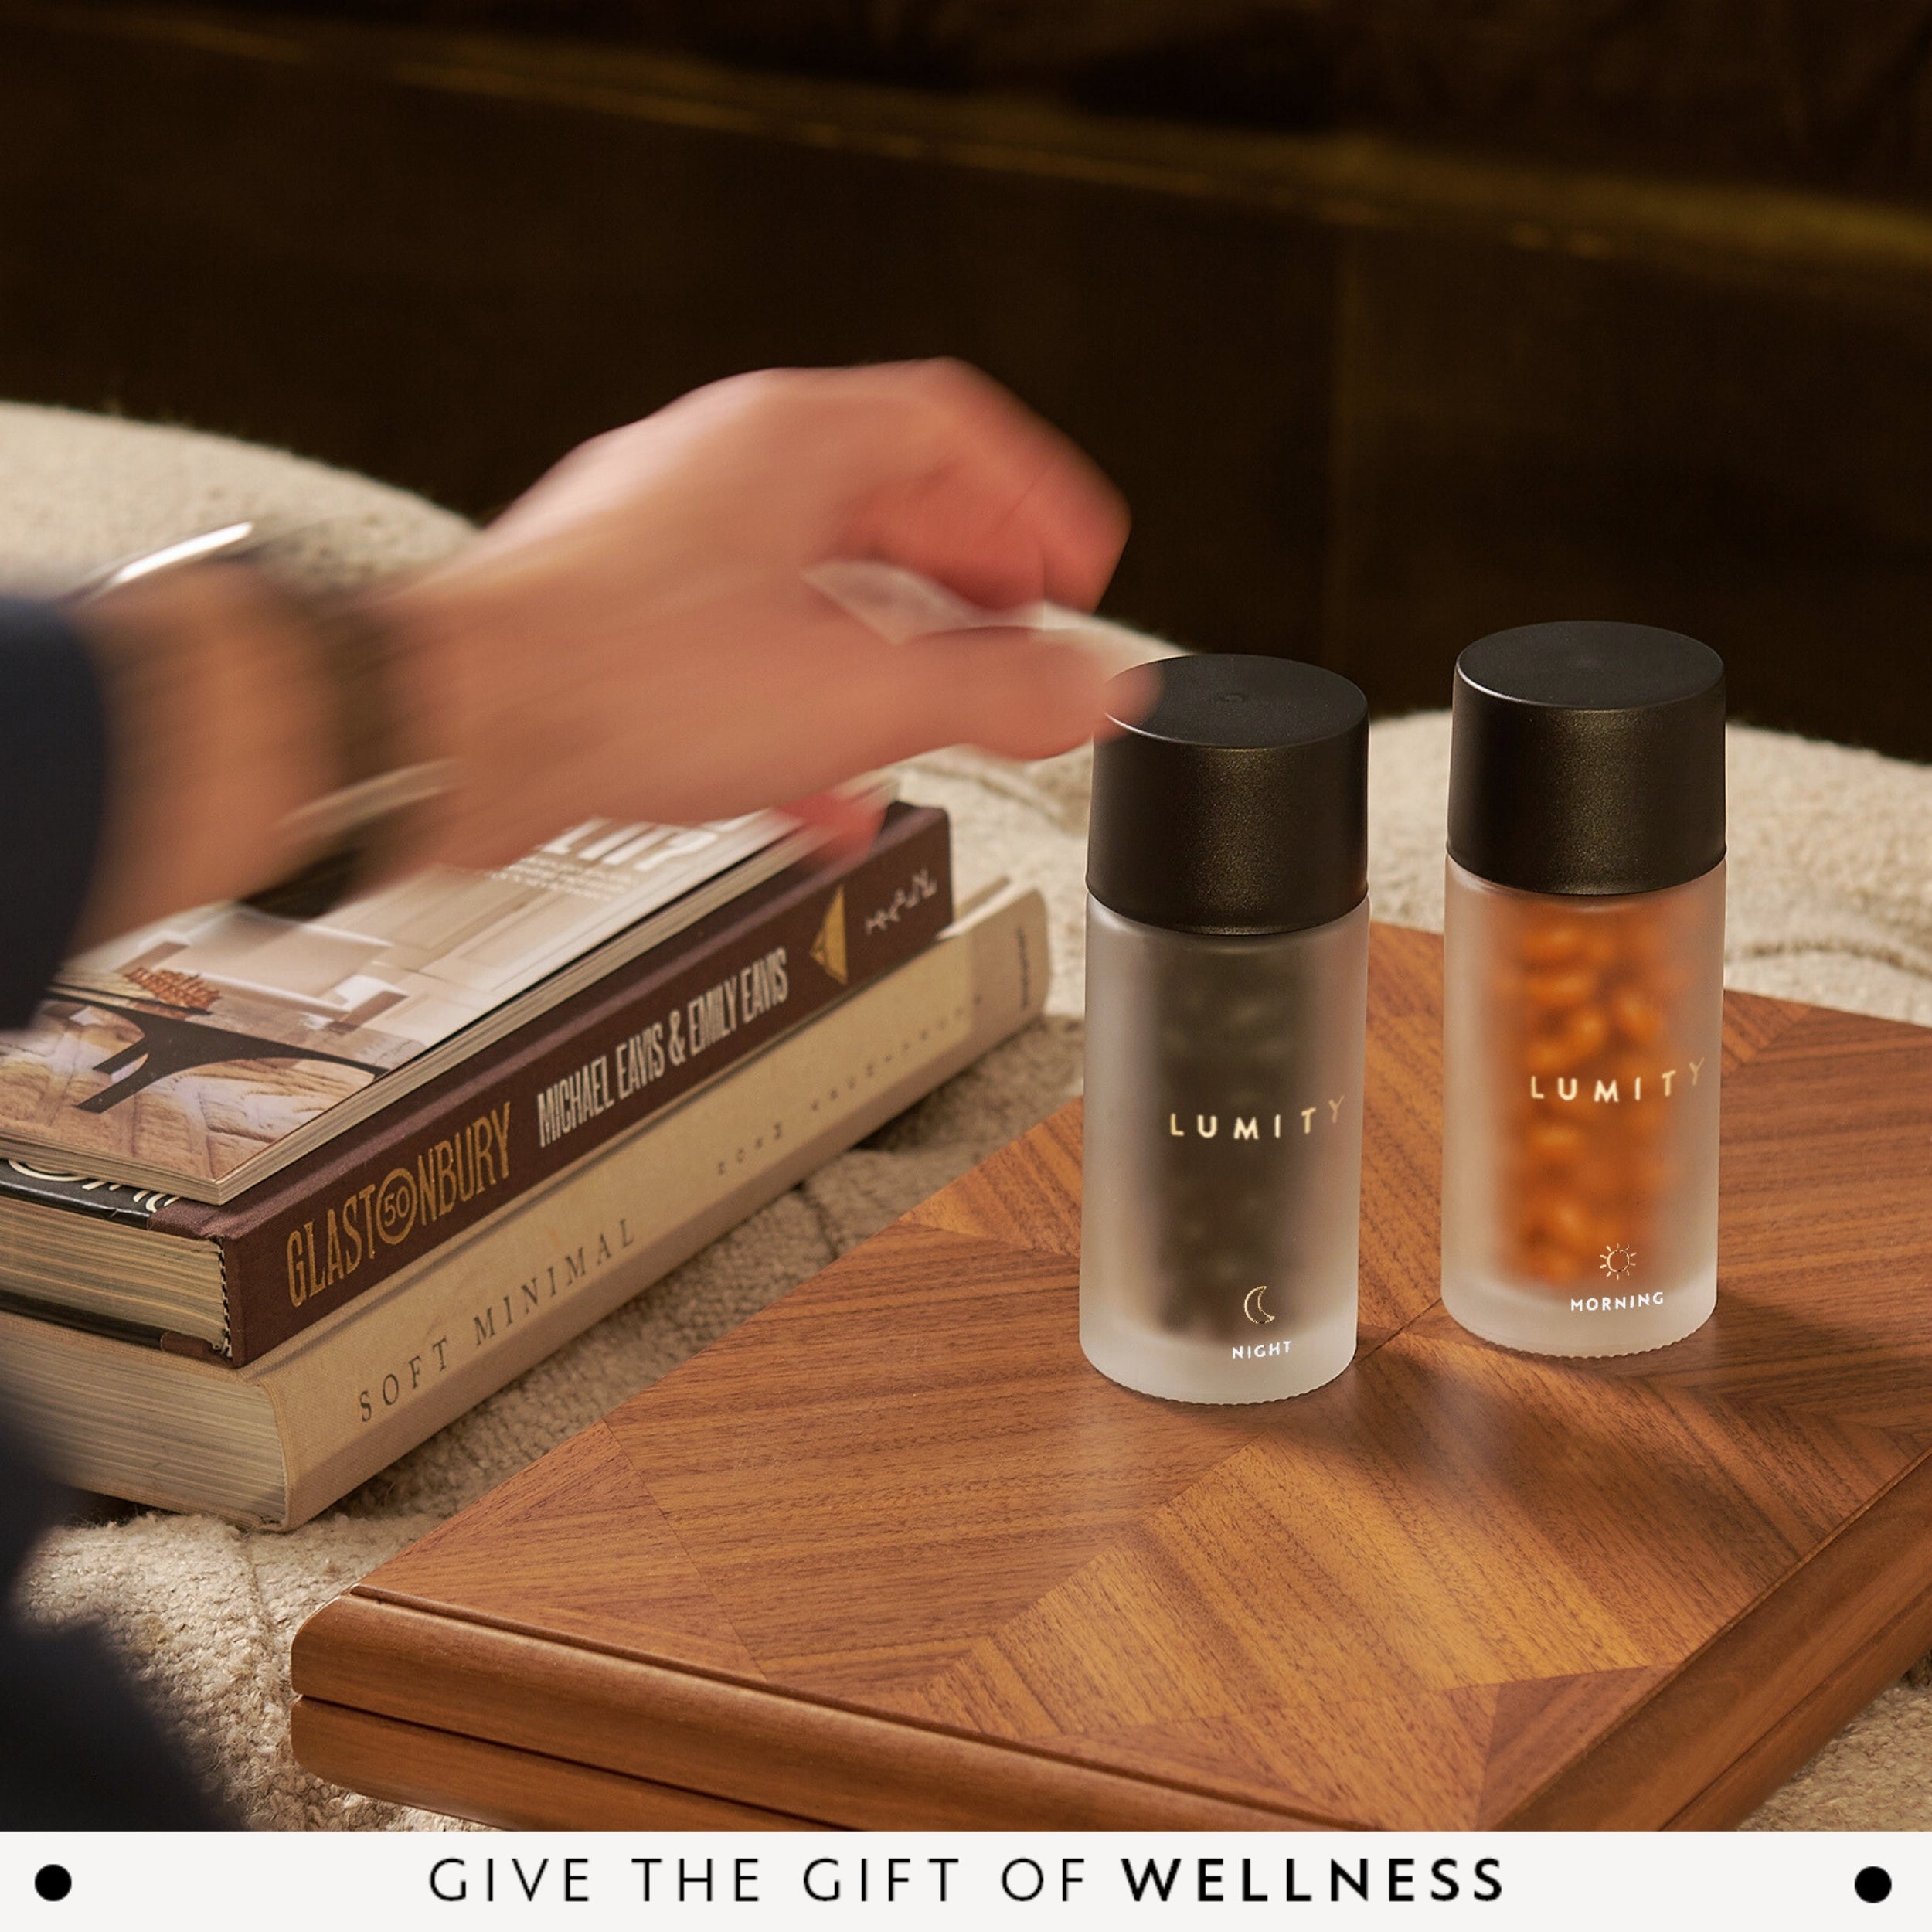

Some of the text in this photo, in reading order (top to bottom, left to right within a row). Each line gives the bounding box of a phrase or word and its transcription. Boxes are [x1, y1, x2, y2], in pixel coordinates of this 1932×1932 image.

[536, 1055, 615, 1148] MICHAEL
[616, 1022, 665, 1100] EAVIS
[668, 1009, 686, 1066] &
[687, 975, 737, 1056] EMILY
[740, 947, 789, 1024] EAVIS
[1531, 1056, 1705, 1104] LUMITY
[1170, 1095, 1345, 1141] LUMITY
[359, 1219, 635, 1423] SOFT MINIMAL
[1570, 1291, 1664, 1312] MORNING
[1232, 1341, 1293, 1359] NIGHT
